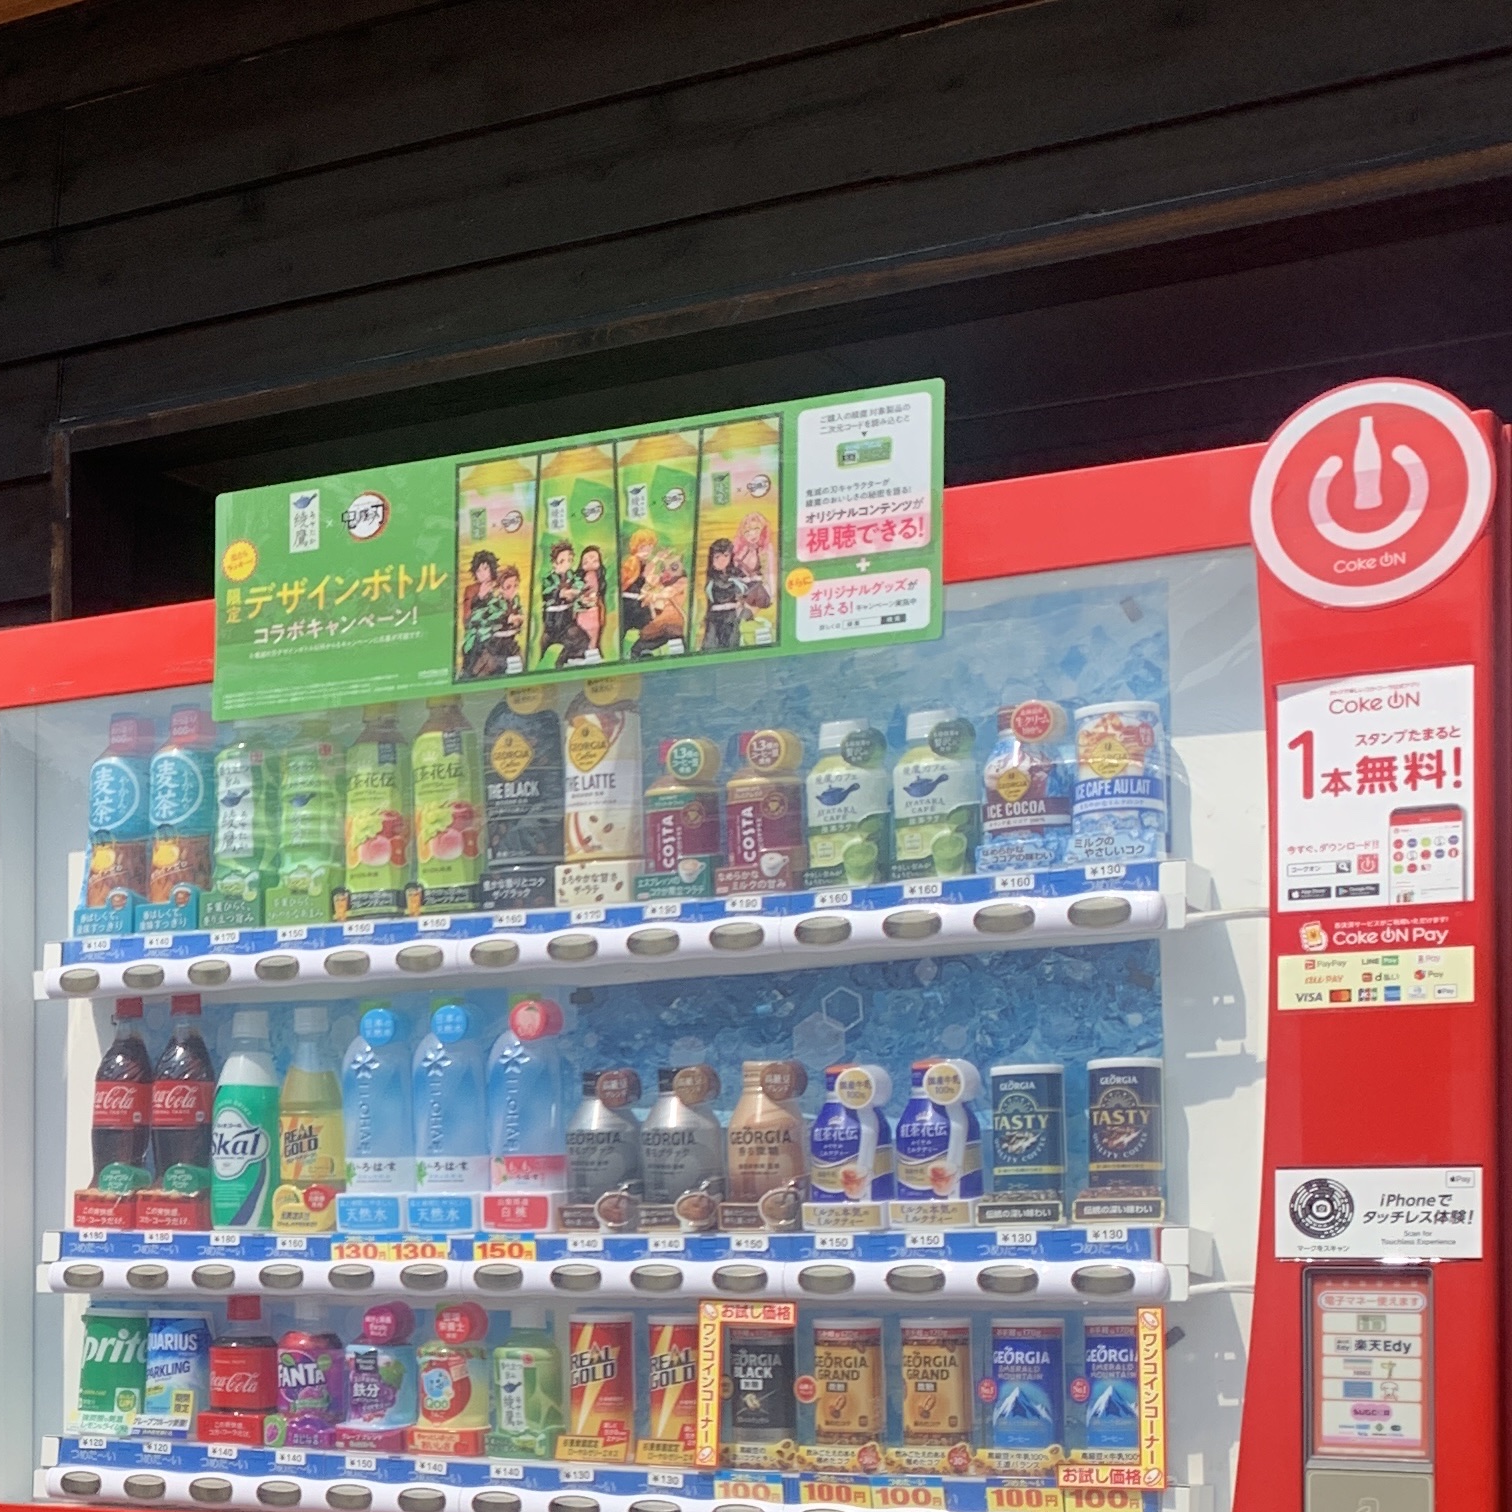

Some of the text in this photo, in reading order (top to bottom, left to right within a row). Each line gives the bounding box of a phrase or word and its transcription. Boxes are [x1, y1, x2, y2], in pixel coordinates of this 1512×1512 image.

[805, 496, 925, 525] オリジナルコンテンツが
[806, 516, 925, 554] 視聴できる!
[1333, 551, 1407, 574] Coke ON
[244, 562, 449, 621] デザインボトル
[811, 577, 919, 602] オリジナルグッズが
[1329, 691, 1421, 715] Coke ON
[1355, 725, 1462, 748] スタンプたまると
[152, 760, 179, 820] 麦茶
[580, 772, 617, 791] LATTE
[1087, 778, 1151, 796] CAFE AU LAIT
[1005, 799, 1047, 816] COCOA
[661, 815, 676, 869] COSTA
[740, 806, 757, 862] COSTA
[1074, 835, 1115, 849] ミルクの
[1084, 843, 1145, 859] やさしいコク
[1090, 864, 1121, 876] ¥130
[909, 884, 939, 896] ¥160
[1000, 876, 1031, 888] ¥160
[819, 892, 849, 904] ¥160
[1333, 930, 1378, 946] Coke
[1412, 927, 1450, 945] Pay
[1295, 991, 1324, 1003] VISA
[1093, 1109, 1152, 1127] TASTY
[1083, 1203, 1154, 1216] 伝統の深い味わい
[1379, 1193, 1454, 1208] iPhoneで
[1362, 1209, 1475, 1226] タッチレス体験!
[819, 1237, 849, 1249] ¥150
[910, 1234, 941, 1246] ¥150
[1001, 1231, 1033, 1243] ¥130
[1091, 1228, 1124, 1241] ¥130
[721, 1303, 792, 1322] お試し価格
[84, 1328, 148, 1368] prit
[1354, 1339, 1413, 1355] 楽天Edy
[571, 1346, 616, 1370] REAL
[650, 1347, 696, 1373] REAL
[278, 1362, 326, 1388] FANTA
[571, 1362, 616, 1389] GOLD
[700, 1322, 717, 1444] ワンコインコーナー
[817, 1369, 861, 1381] GRAND
[906, 1369, 951, 1381] GRAND
[352, 1383, 381, 1399] 鉄分
[1142, 1333, 1160, 1465] ワンコインコーナー
[349, 1459, 373, 1469] ¥150
[419, 1462, 444, 1473] ¥140
[494, 1467, 521, 1477] ¥140
[1062, 1467, 1141, 1485] お試し価格
[804, 1484, 867, 1504] 100円
[991, 1488, 1059, 1508] 100円
